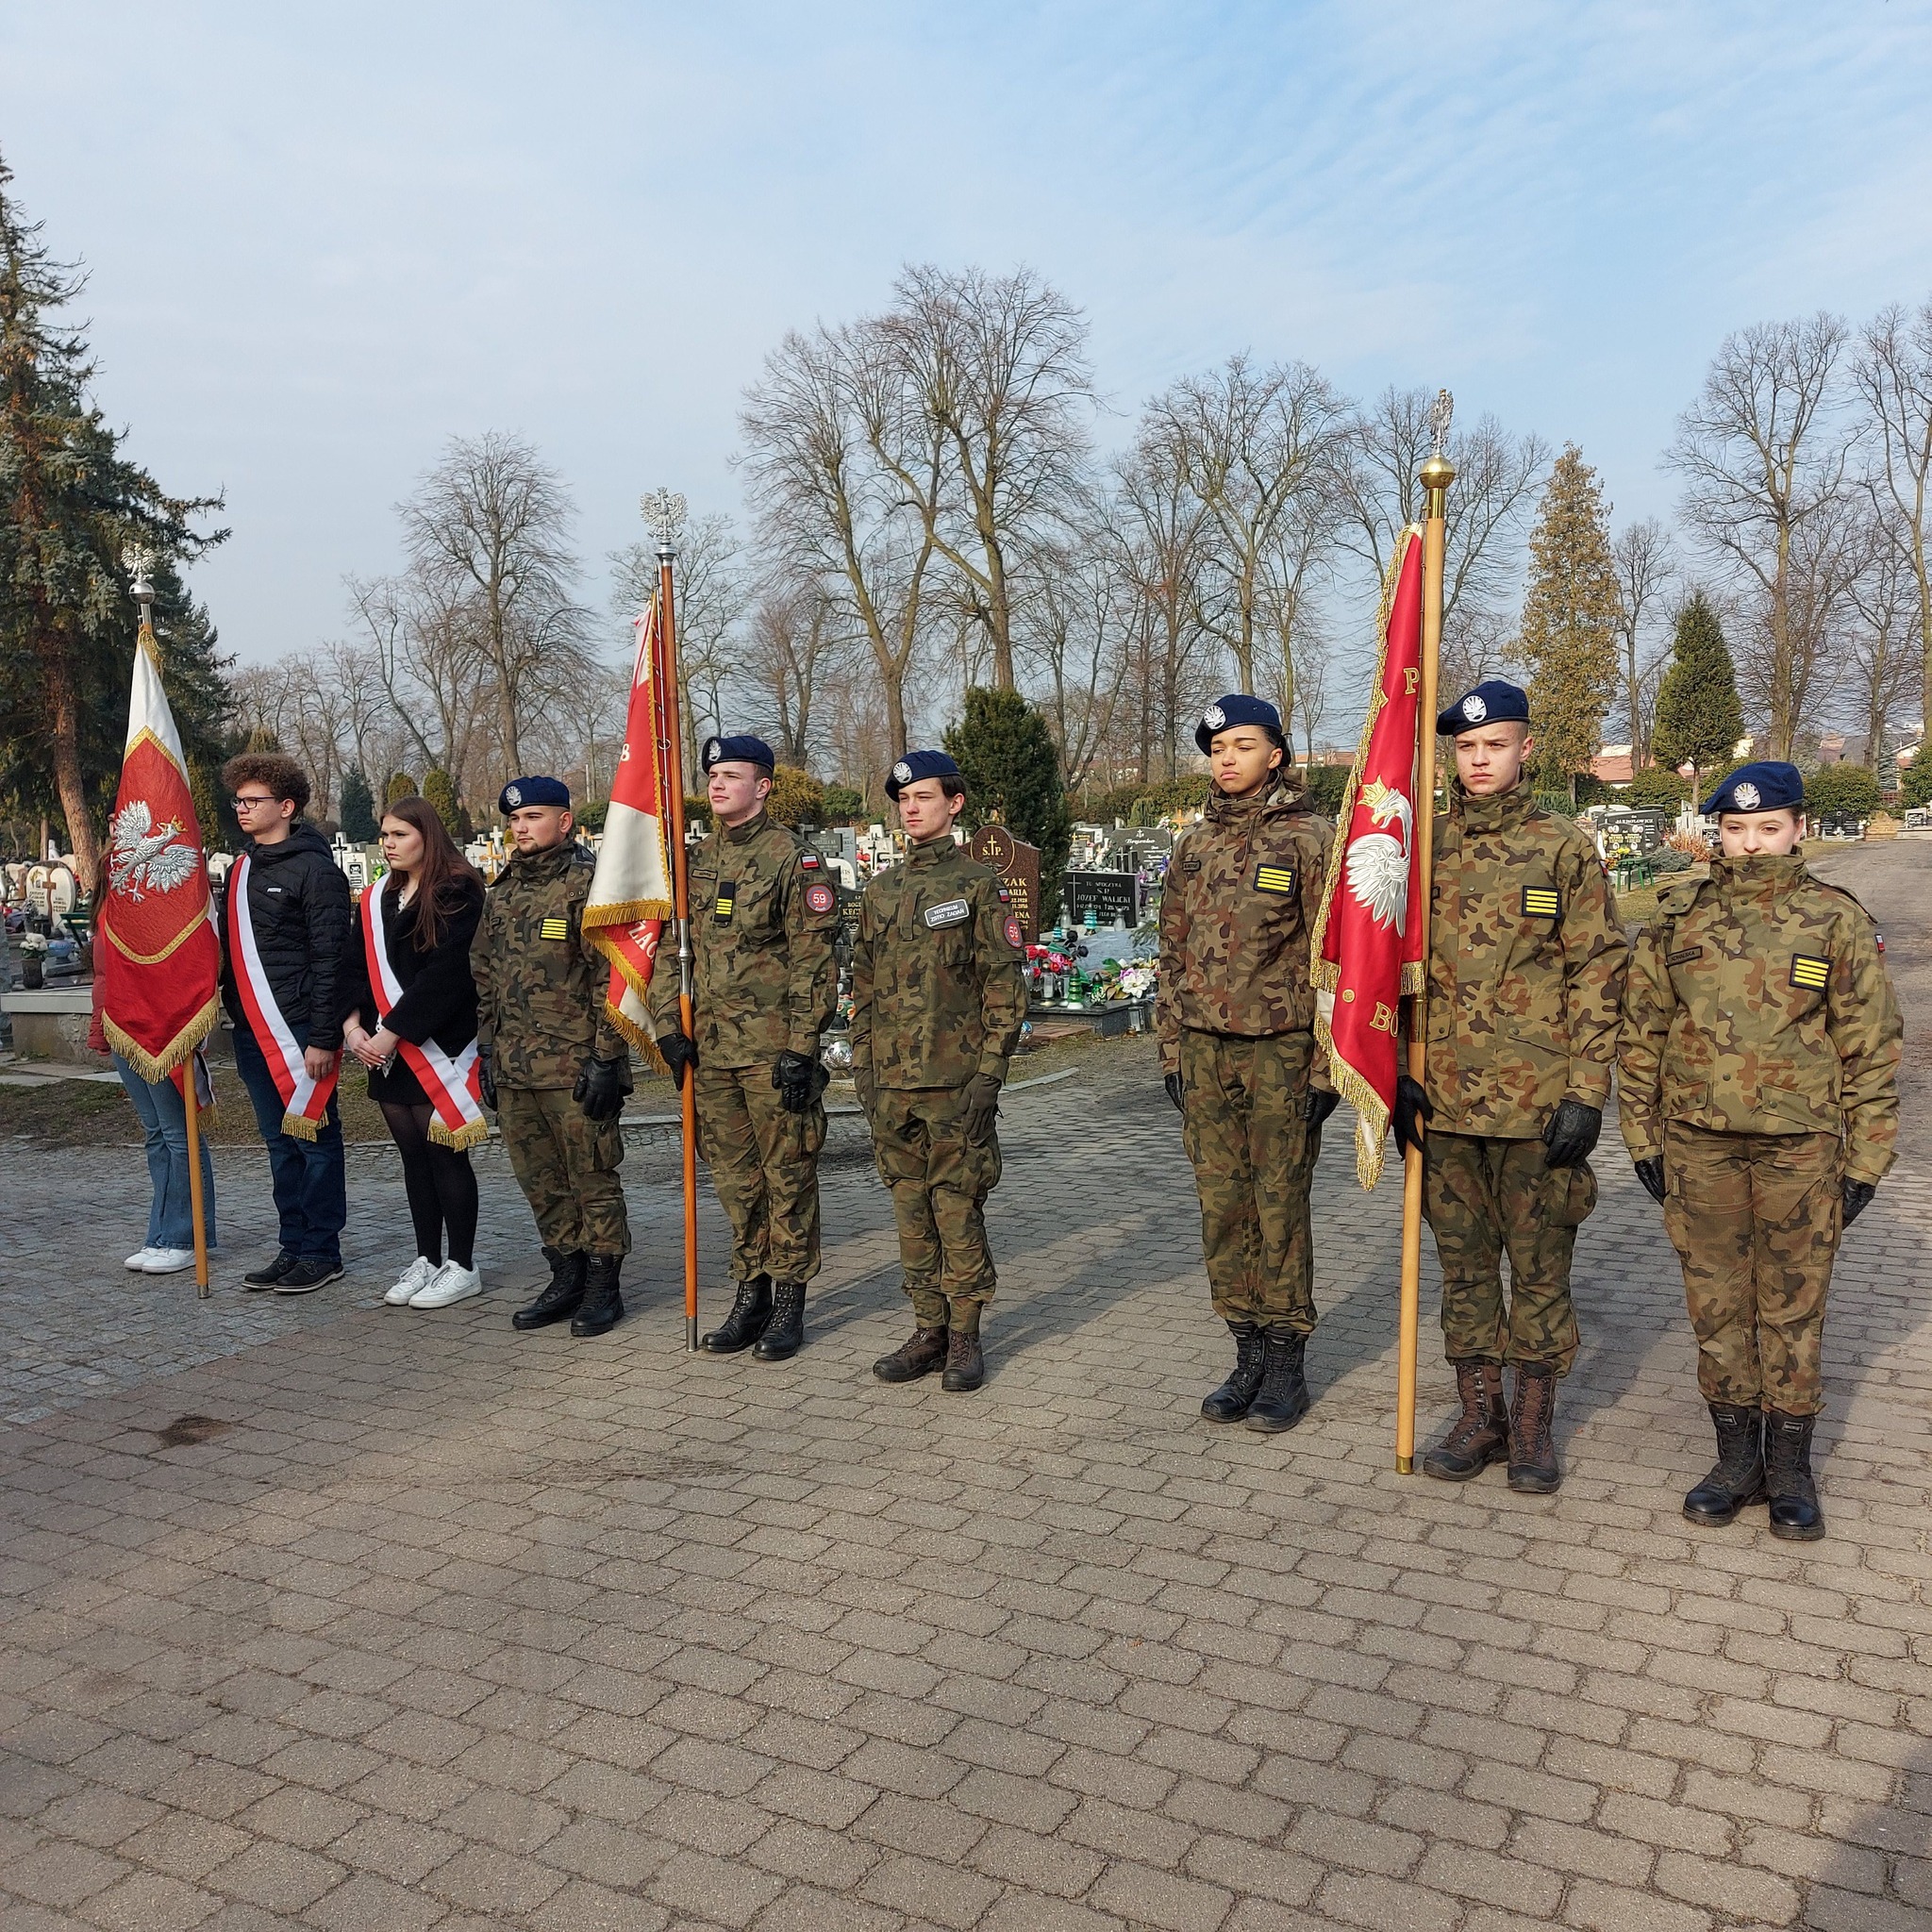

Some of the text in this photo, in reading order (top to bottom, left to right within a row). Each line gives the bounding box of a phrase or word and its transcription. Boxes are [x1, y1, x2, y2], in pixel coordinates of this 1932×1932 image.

[1001, 877, 1027, 887] ZAK
[813, 893, 826, 904] 59
[1008, 925, 1019, 939] 59
